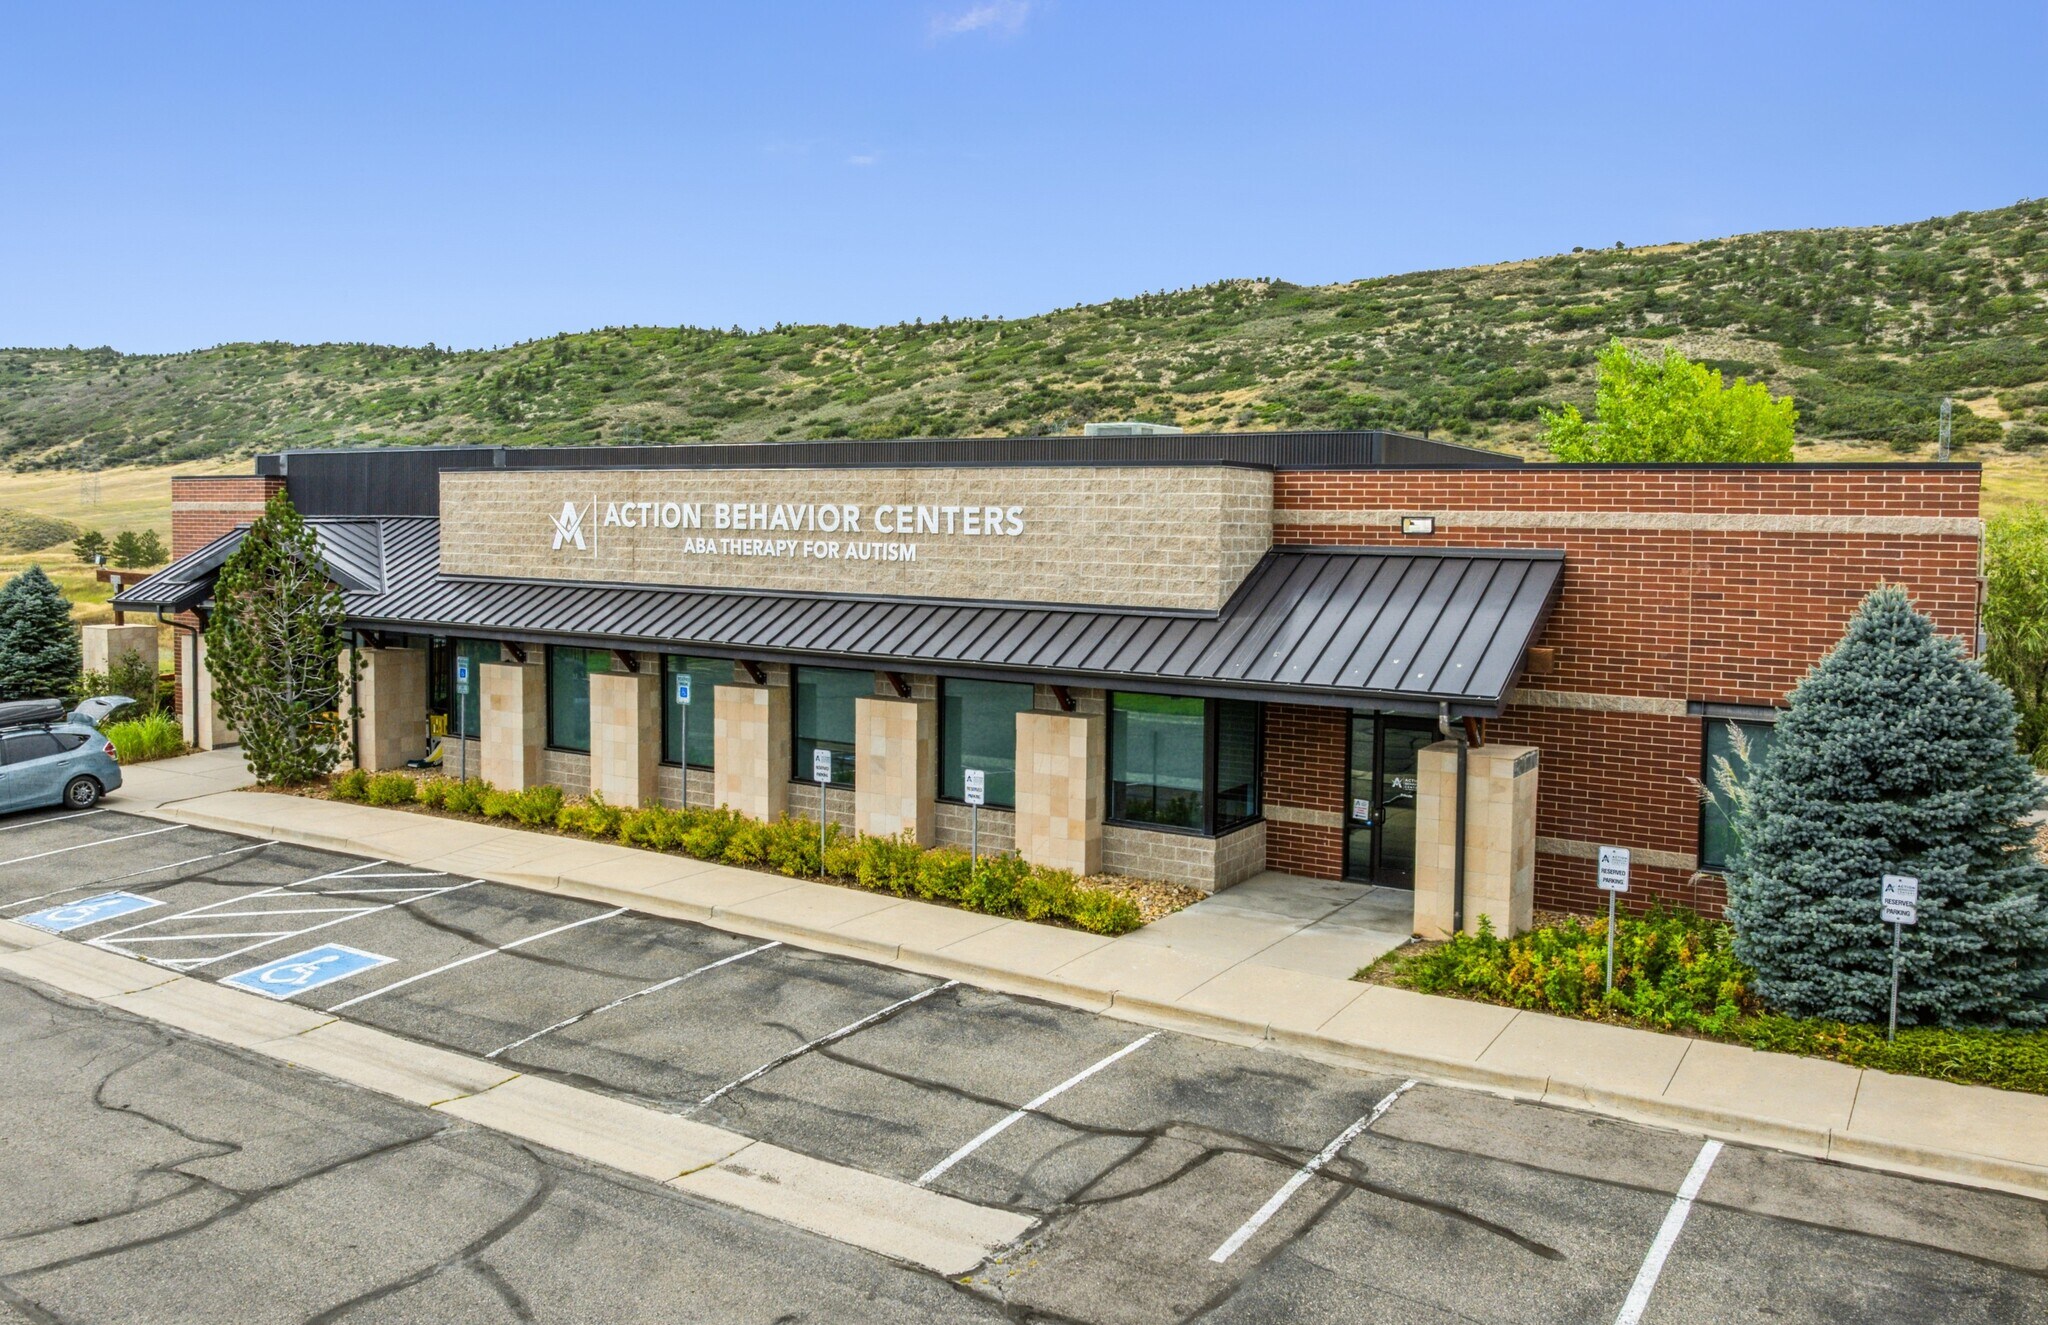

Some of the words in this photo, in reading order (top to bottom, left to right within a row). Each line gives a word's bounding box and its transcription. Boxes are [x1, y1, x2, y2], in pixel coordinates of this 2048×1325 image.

[603, 502, 702, 529] ACTION
[715, 503, 861, 533] BEHAVIOR
[874, 506, 1025, 536] CENTERS
[683, 537, 718, 554] ABA
[720, 538, 799, 558] THERAPY
[803, 541, 840, 560] FOR
[844, 542, 917, 562] AUTISM
[1600, 867, 1626, 877] RESERVED
[1602, 877, 1624, 885] PARKING
[1884, 898, 1914, 907] RESERVED
[1886, 908, 1911, 917] PARKING
